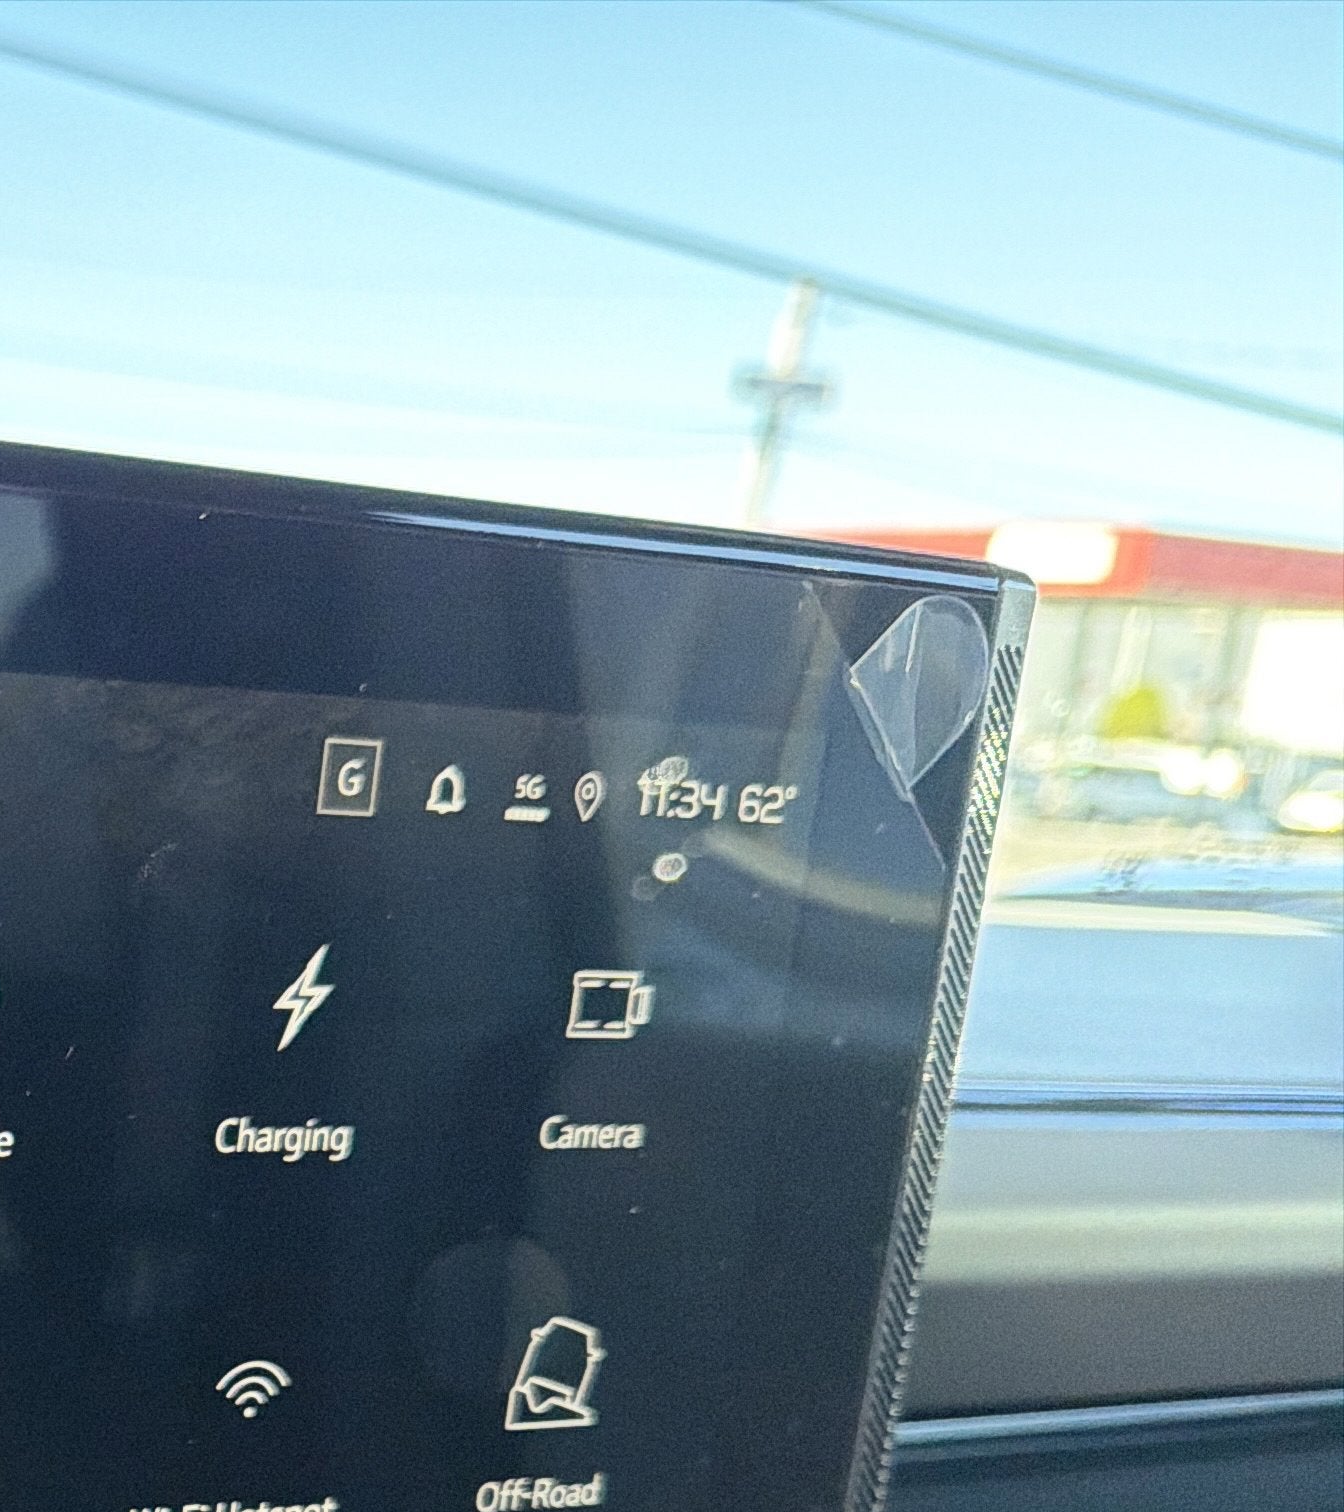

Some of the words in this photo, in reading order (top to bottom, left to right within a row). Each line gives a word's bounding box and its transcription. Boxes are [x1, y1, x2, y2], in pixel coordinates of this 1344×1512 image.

[337, 759, 364, 797] G
[514, 774, 547, 800] 5G
[637, 778, 729, 821] 11:34
[738, 784, 800, 824] 62°
[214, 1116, 354, 1163] Charging
[539, 1115, 645, 1150] Camera
